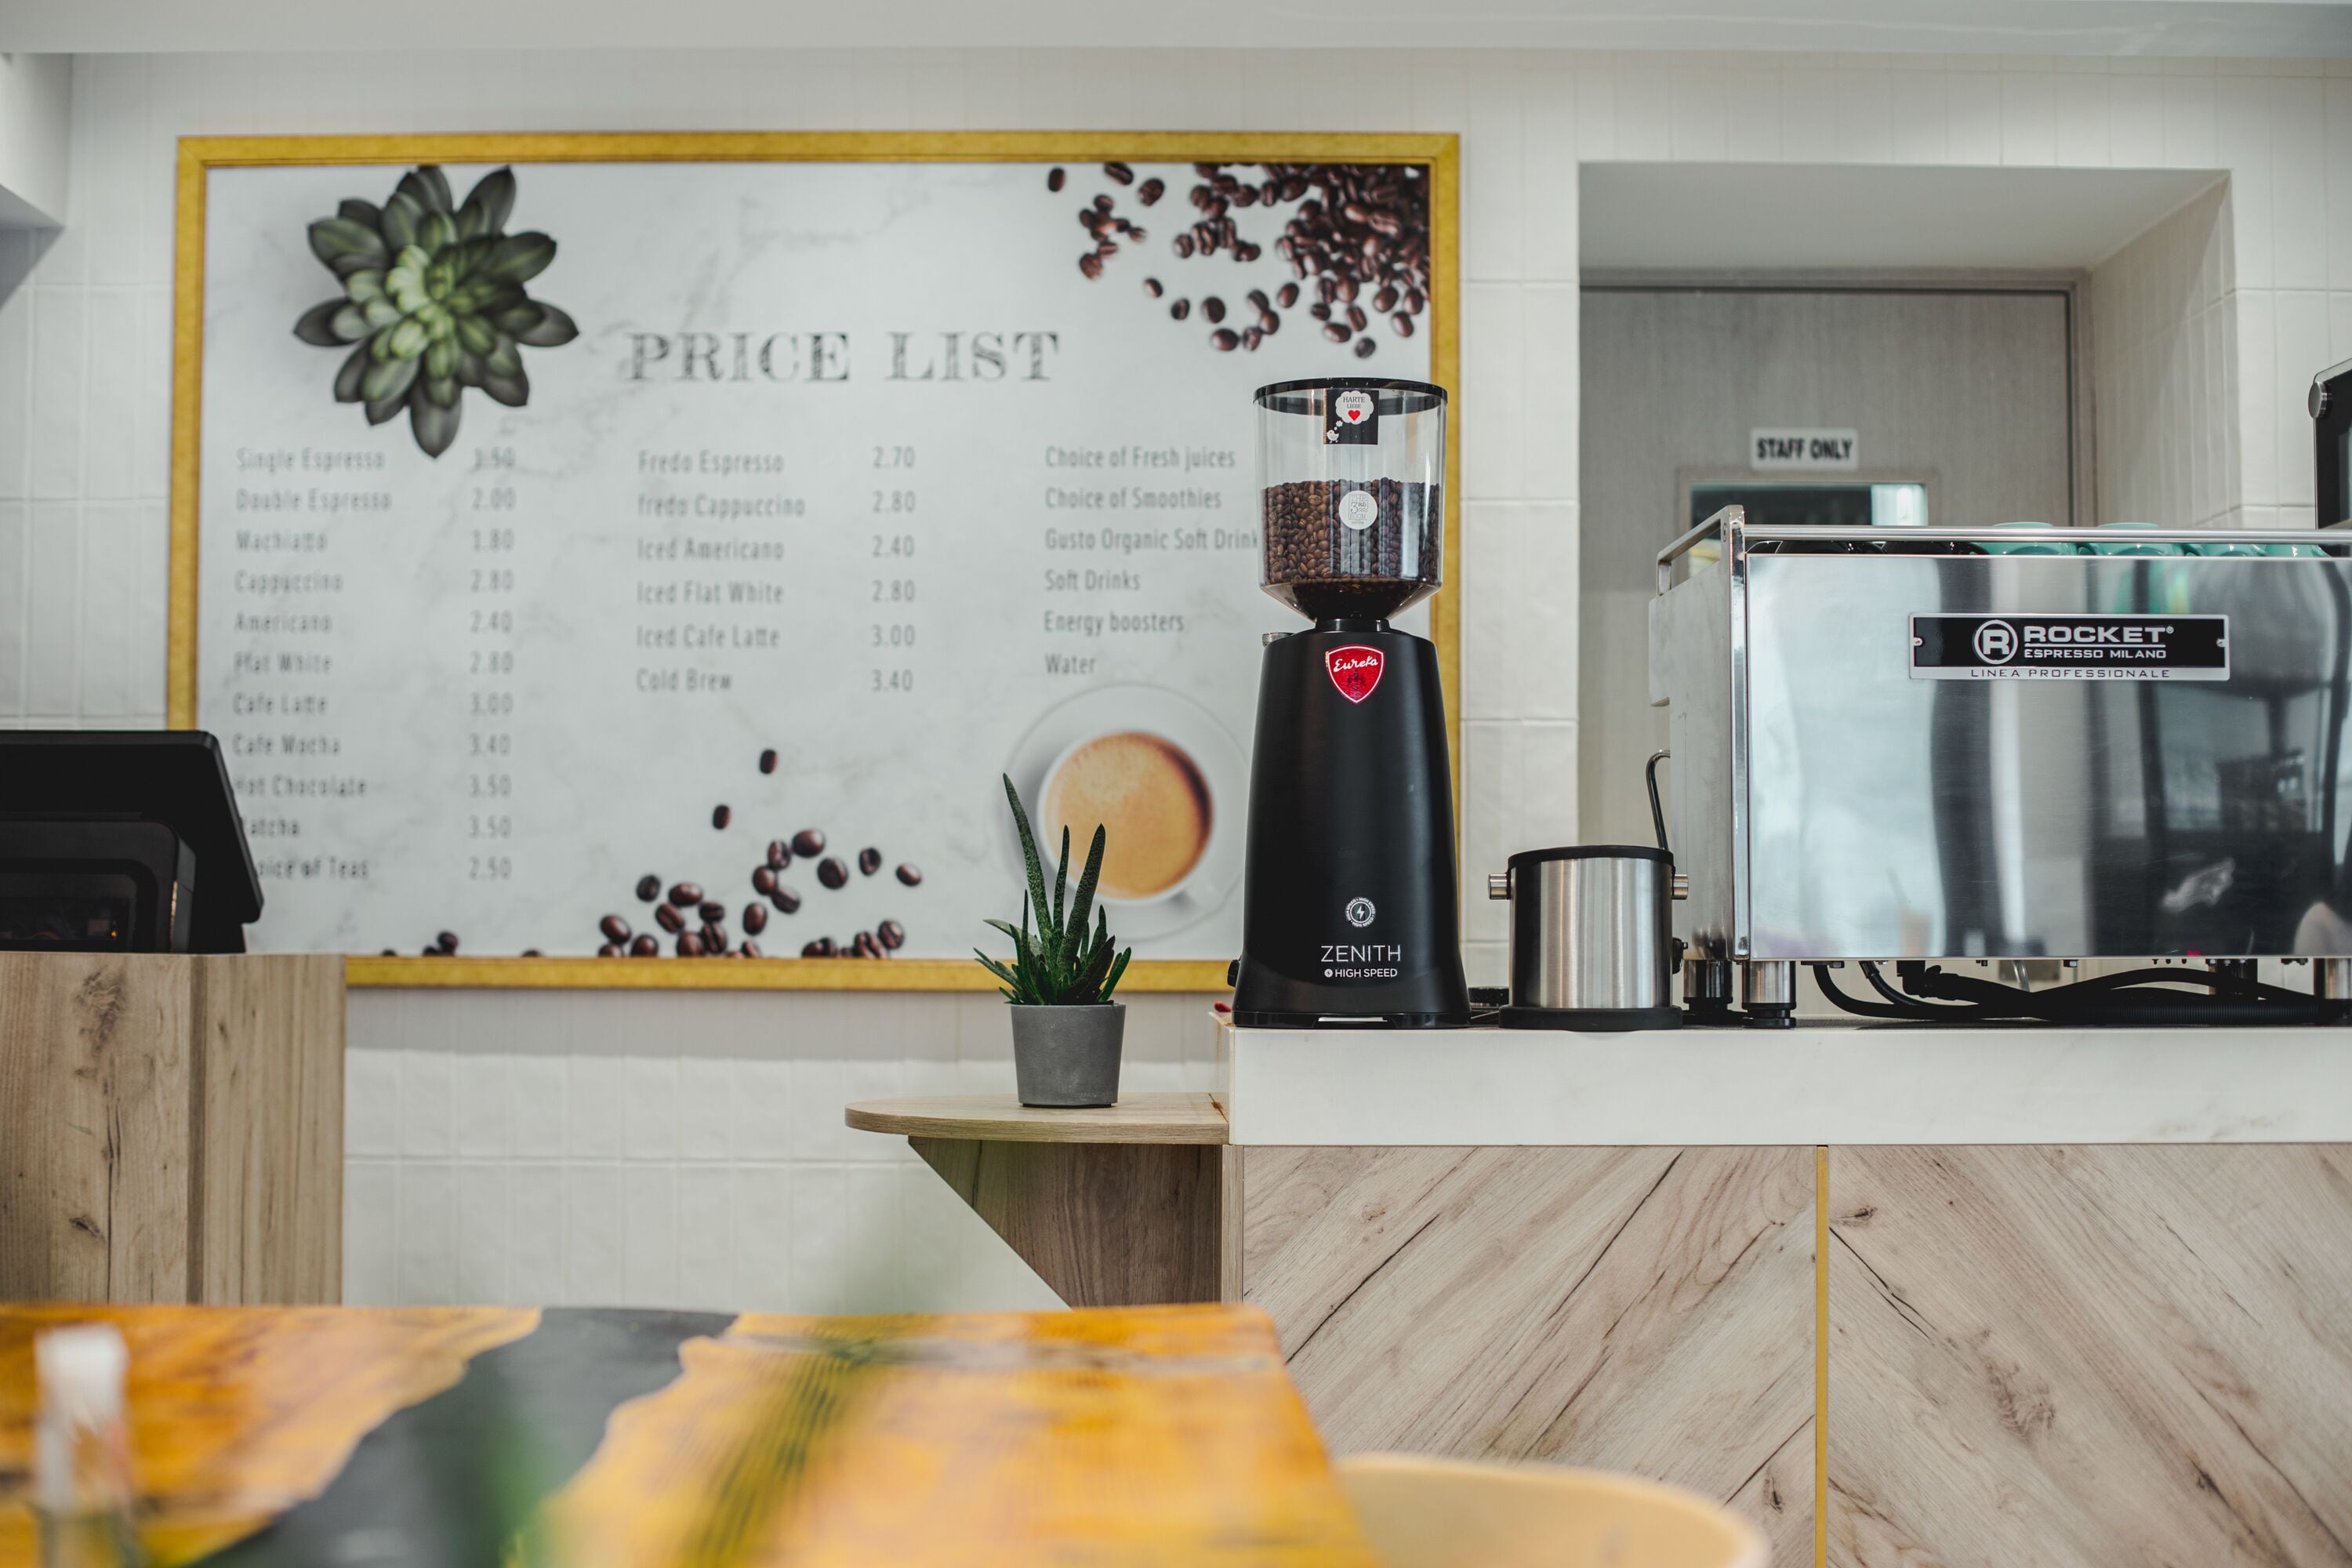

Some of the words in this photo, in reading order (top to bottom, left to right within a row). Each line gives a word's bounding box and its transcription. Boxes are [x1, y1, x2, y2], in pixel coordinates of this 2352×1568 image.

[625, 332, 851, 382] PRICE
[884, 332, 1060, 381] LIST
[1045, 446, 1105, 468] Choice
[1109, 446, 1127, 468] of
[1133, 447, 1179, 468] Fresh
[1185, 448, 1236, 472] juices
[1757, 437, 1806, 460] STAFF
[1809, 437, 1853, 460] ONLY
[237, 447, 296, 475] Single
[301, 447, 386, 474] Espresso
[638, 450, 692, 473] Fredo
[699, 450, 784, 476] Espresso
[872, 446, 916, 469] 2.70
[237, 488, 301, 511] Double
[307, 488, 392, 514] Espresso
[471, 488, 516, 511] 2.00
[695, 493, 806, 520] Cappuccino
[872, 491, 916, 514] 2.80
[1045, 487, 1105, 510] Choice
[1109, 487, 1127, 510] of
[1134, 487, 1221, 510] Smoothies
[637, 538, 677, 561] Iced
[684, 538, 784, 561] Americano
[872, 535, 916, 558] 2.40
[1045, 528, 1096, 550] Gusto
[1102, 528, 1169, 555] Organic
[1174, 528, 1208, 550] Soft
[234, 569, 345, 594] Cappuccino
[471, 569, 516, 593] 2.80
[637, 580, 677, 604] Iced
[684, 580, 721, 604] Flat
[728, 580, 784, 604] White
[872, 579, 916, 603] 2.80
[1045, 569, 1079, 591] Soft
[1085, 569, 1141, 591] Drinks
[234, 612, 333, 633] Americano
[1045, 610, 1104, 636] Energy
[1110, 610, 1185, 632] boosters
[637, 625, 677, 648] Iced
[684, 625, 726, 648] Cafe
[732, 625, 779, 648] Latte
[872, 624, 916, 648] 3.00
[278, 651, 332, 674] White
[1045, 653, 1097, 675] Water
[1333, 655, 1379, 673] Eureka
[2024, 649, 2103, 659] ESPRESSO
[2110, 650, 2166, 659] MILANO
[636, 669, 679, 692] Cold
[685, 669, 732, 692] Brew
[872, 670, 916, 692] 3.40
[2029, 670, 2170, 678] PROFESSIONALE
[233, 691, 274, 715] Cafe
[279, 691, 328, 715] Latte
[471, 691, 513, 717] 3.00
[233, 732, 274, 756] Cafe
[271, 773, 367, 797] Chocolate
[242, 815, 300, 837] atcha
[328, 855, 370, 880] Teas
[471, 855, 513, 880] 2.50
[1320, 945, 1402, 962] ZENITH
[1334, 968, 1362, 978] HIGH
[1363, 968, 1398, 978] SPEED
